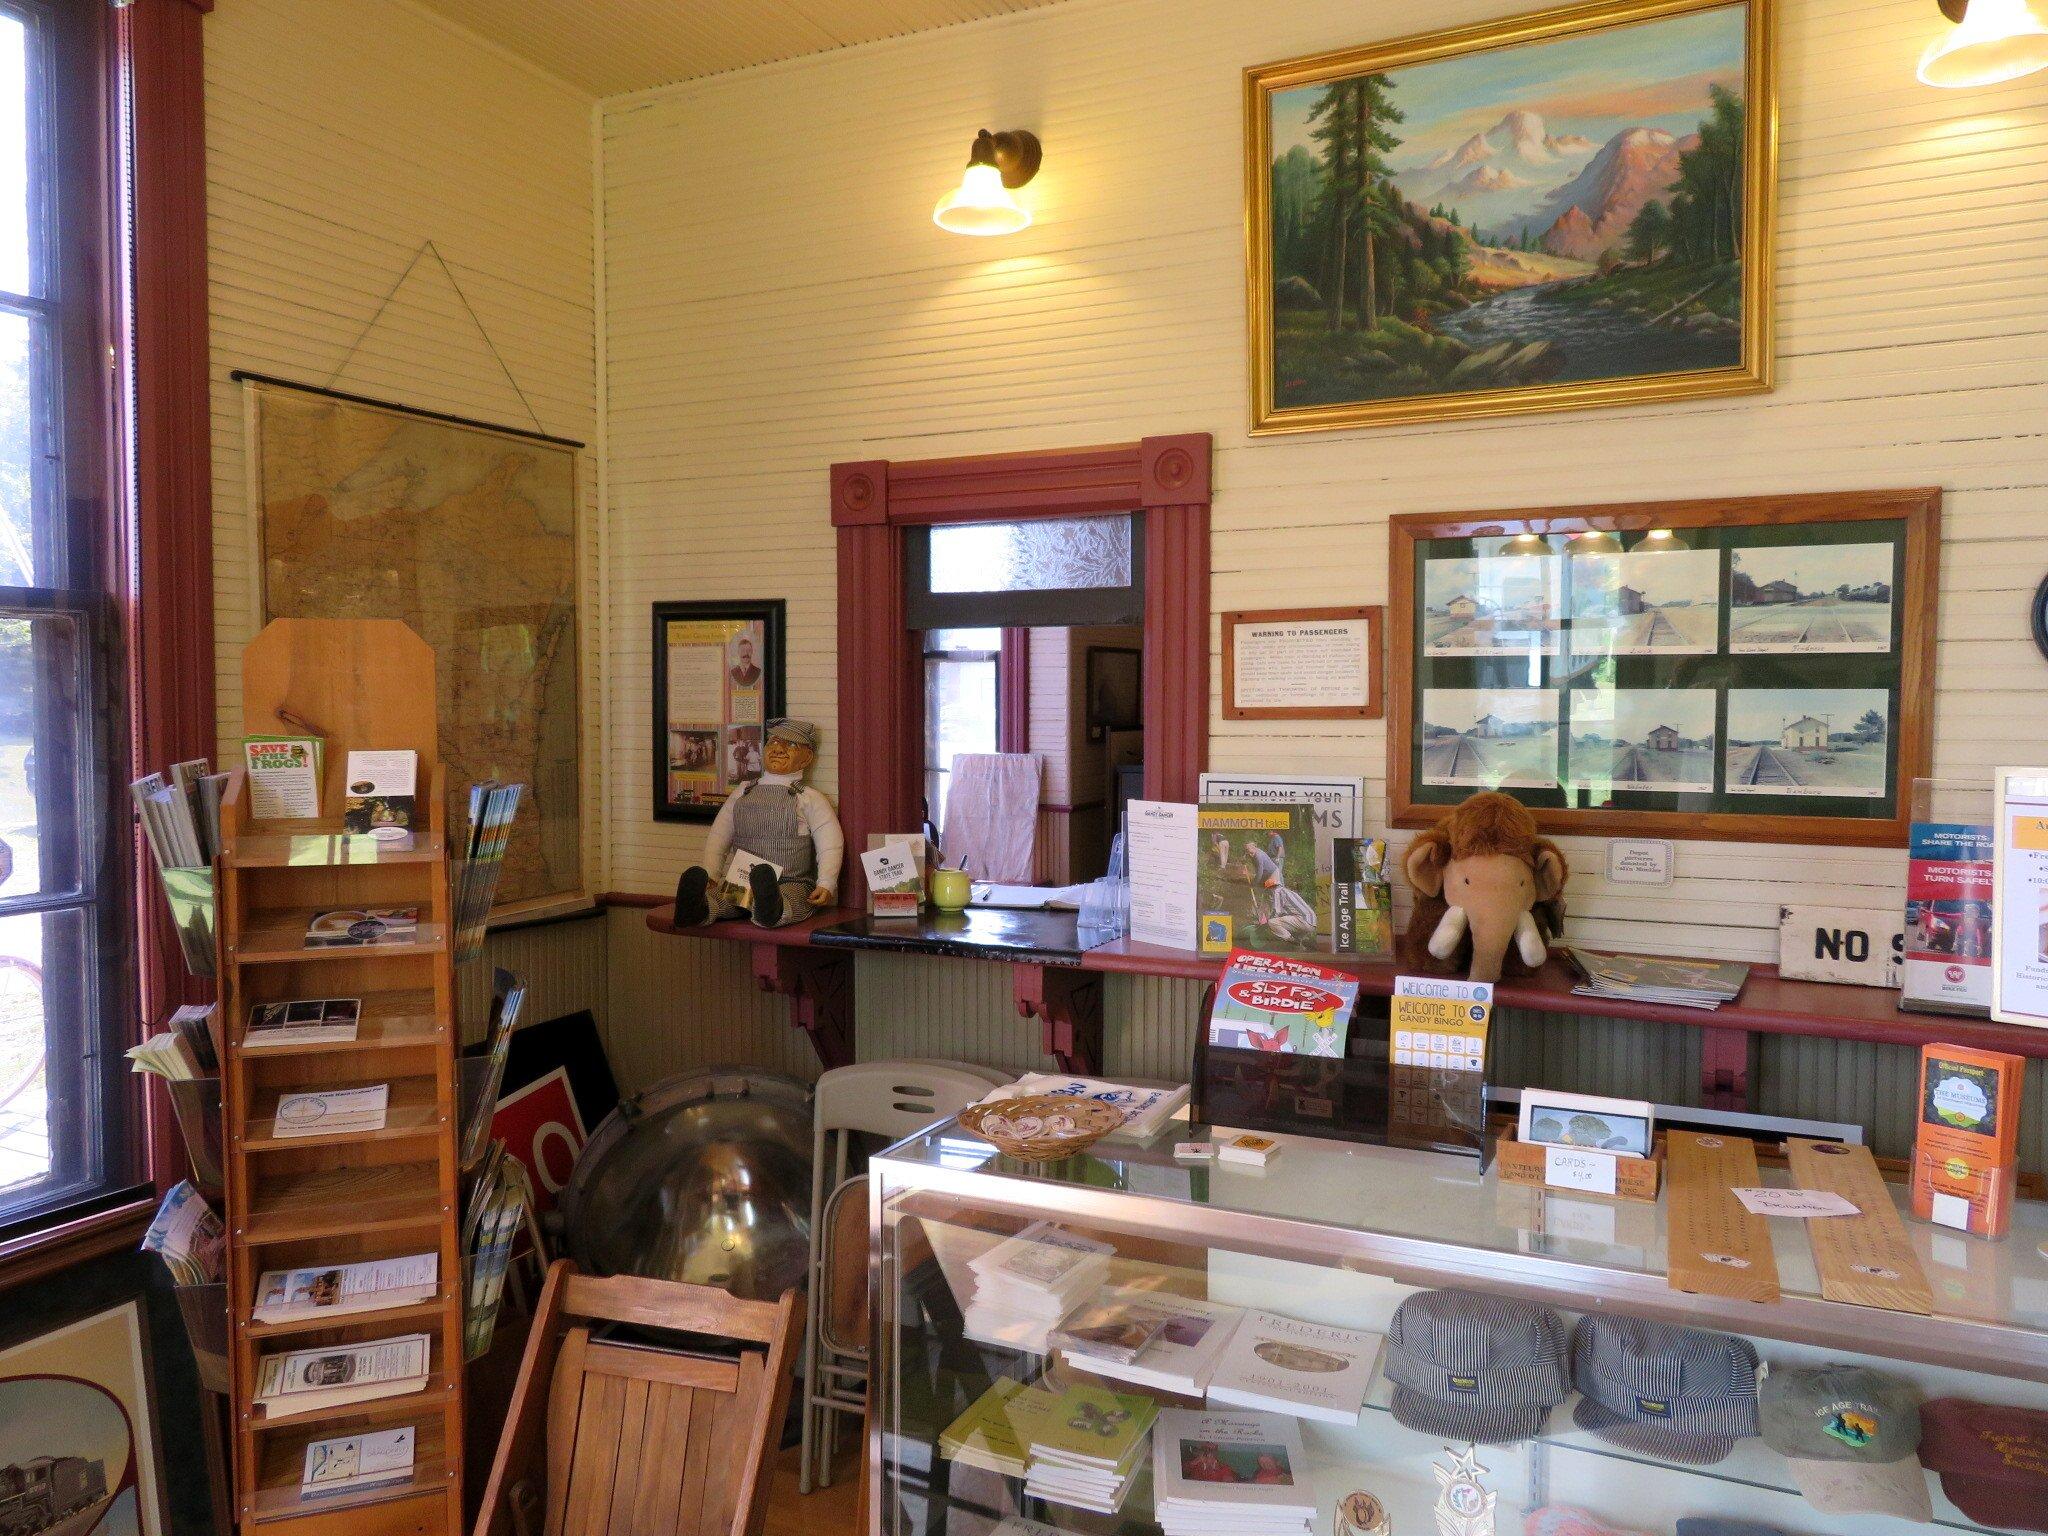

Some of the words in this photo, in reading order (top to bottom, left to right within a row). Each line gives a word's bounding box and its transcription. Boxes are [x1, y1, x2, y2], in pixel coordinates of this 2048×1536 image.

[1251, 630, 1284, 638] WARNING
[1300, 628, 1348, 636] PASSENGERS
[249, 743, 288, 757] SAVE
[1219, 789, 1297, 802] TELEPHONE
[1304, 791, 1342, 803] YOUR
[1202, 818, 1264, 828] MAMMOTH
[1265, 818, 1288, 828] tales
[1924, 874, 1954, 883] TURN
[1957, 877, 1993, 885] SAFEL
[1338, 882, 1349, 904] Trail
[1339, 908, 1351, 929] Age
[1339, 930, 1349, 948] Ice
[1814, 927, 1869, 963] NO
[1236, 955, 1322, 978] OPERATION
[1251, 981, 1287, 995] SLY
[1456, 985, 1469, 999] TO
[1238, 989, 1251, 998] &
[1252, 995, 1315, 1011] BIRDIE
[1453, 1004, 1466, 1018] TO
[1399, 1014, 1431, 1025] GANDY
[1434, 1018, 1464, 1027] BINGO
[1554, 1157, 1587, 1168] CARDS
[1259, 1315, 1366, 1341] FREDERIC
[1832, 1401, 1852, 1411] AGE
